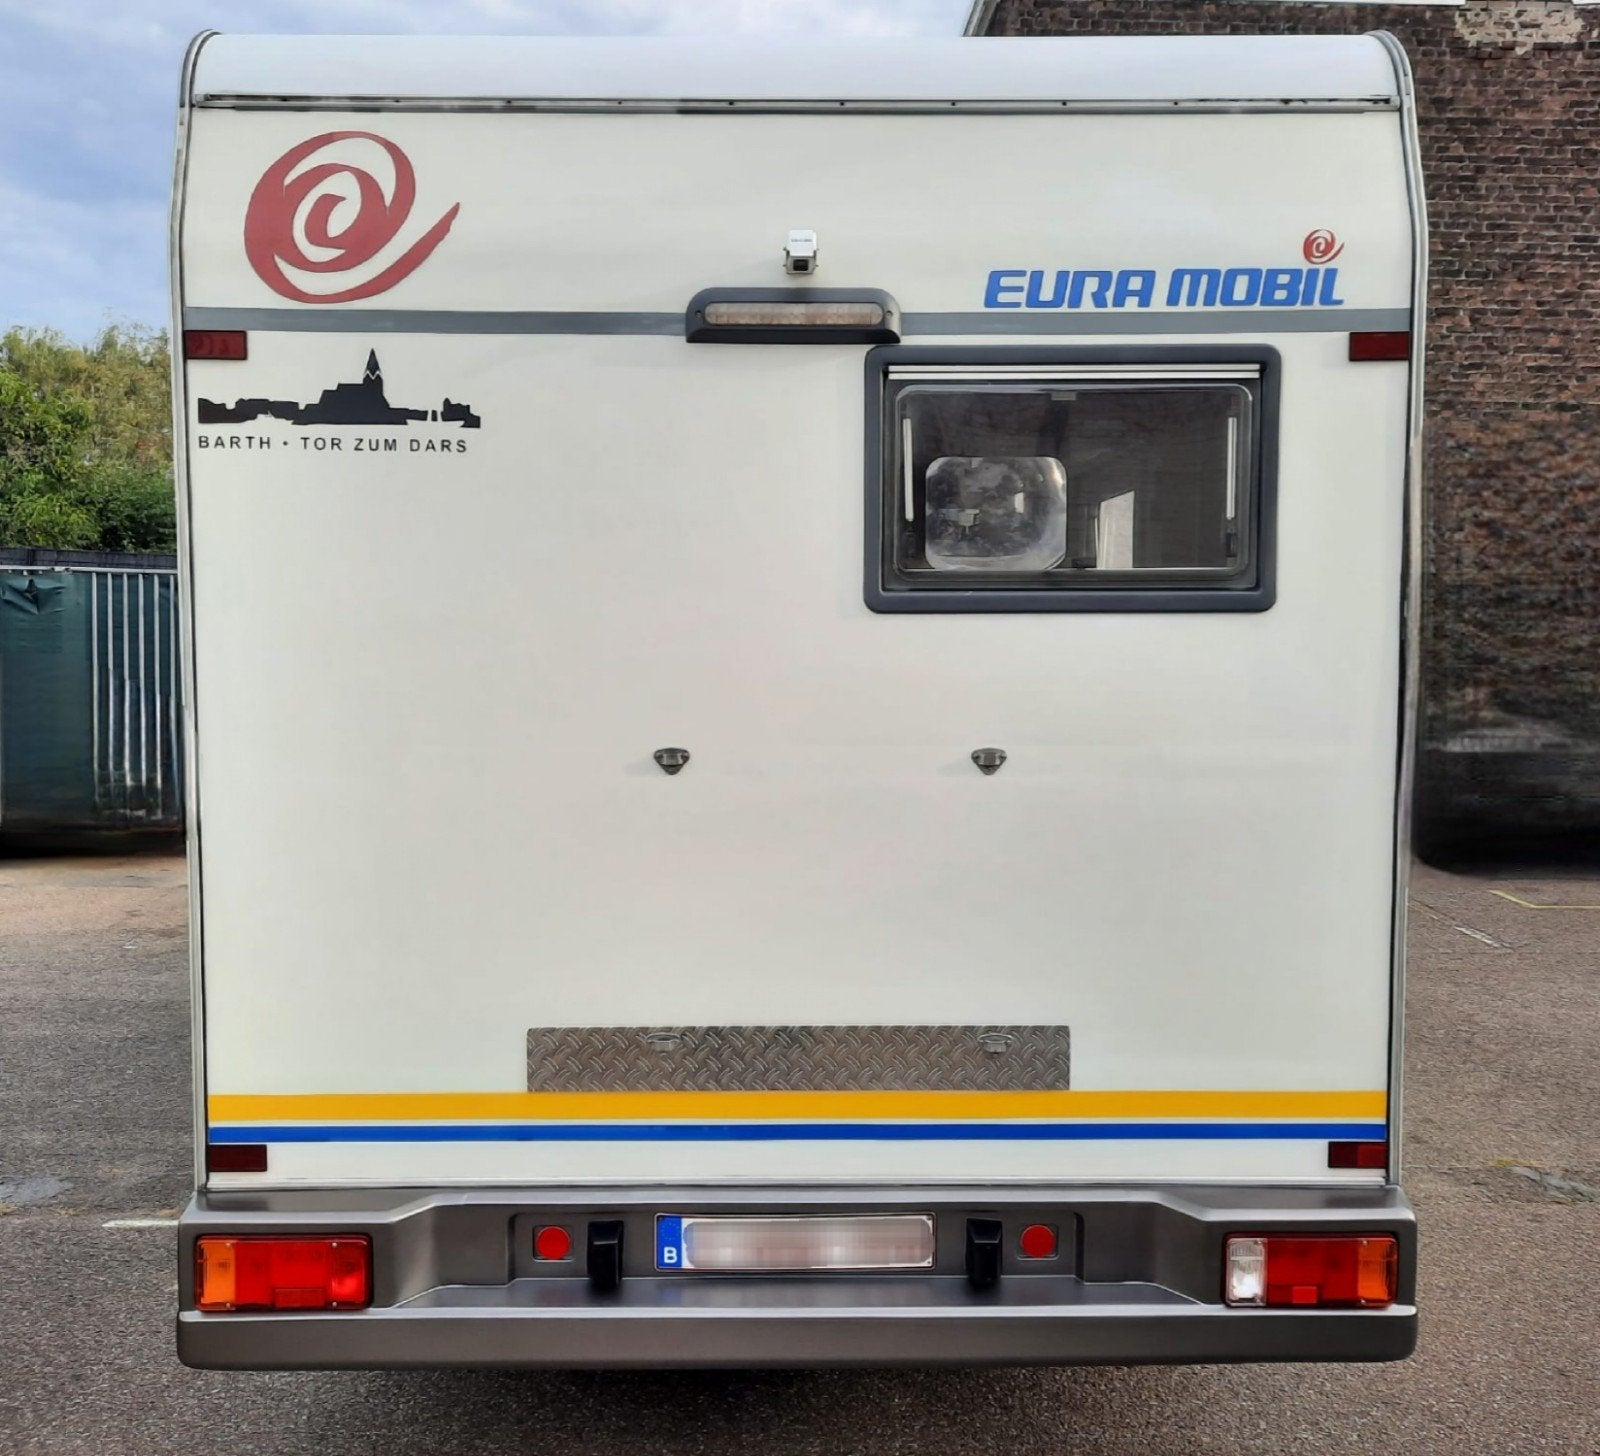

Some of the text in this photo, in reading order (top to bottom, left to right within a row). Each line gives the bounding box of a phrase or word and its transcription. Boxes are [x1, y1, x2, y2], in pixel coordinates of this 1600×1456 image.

[984, 268, 1344, 308] EURA MOBIL
[198, 435, 467, 453] BARTH TOR ZUM DARS
[663, 1247, 678, 1264] B
